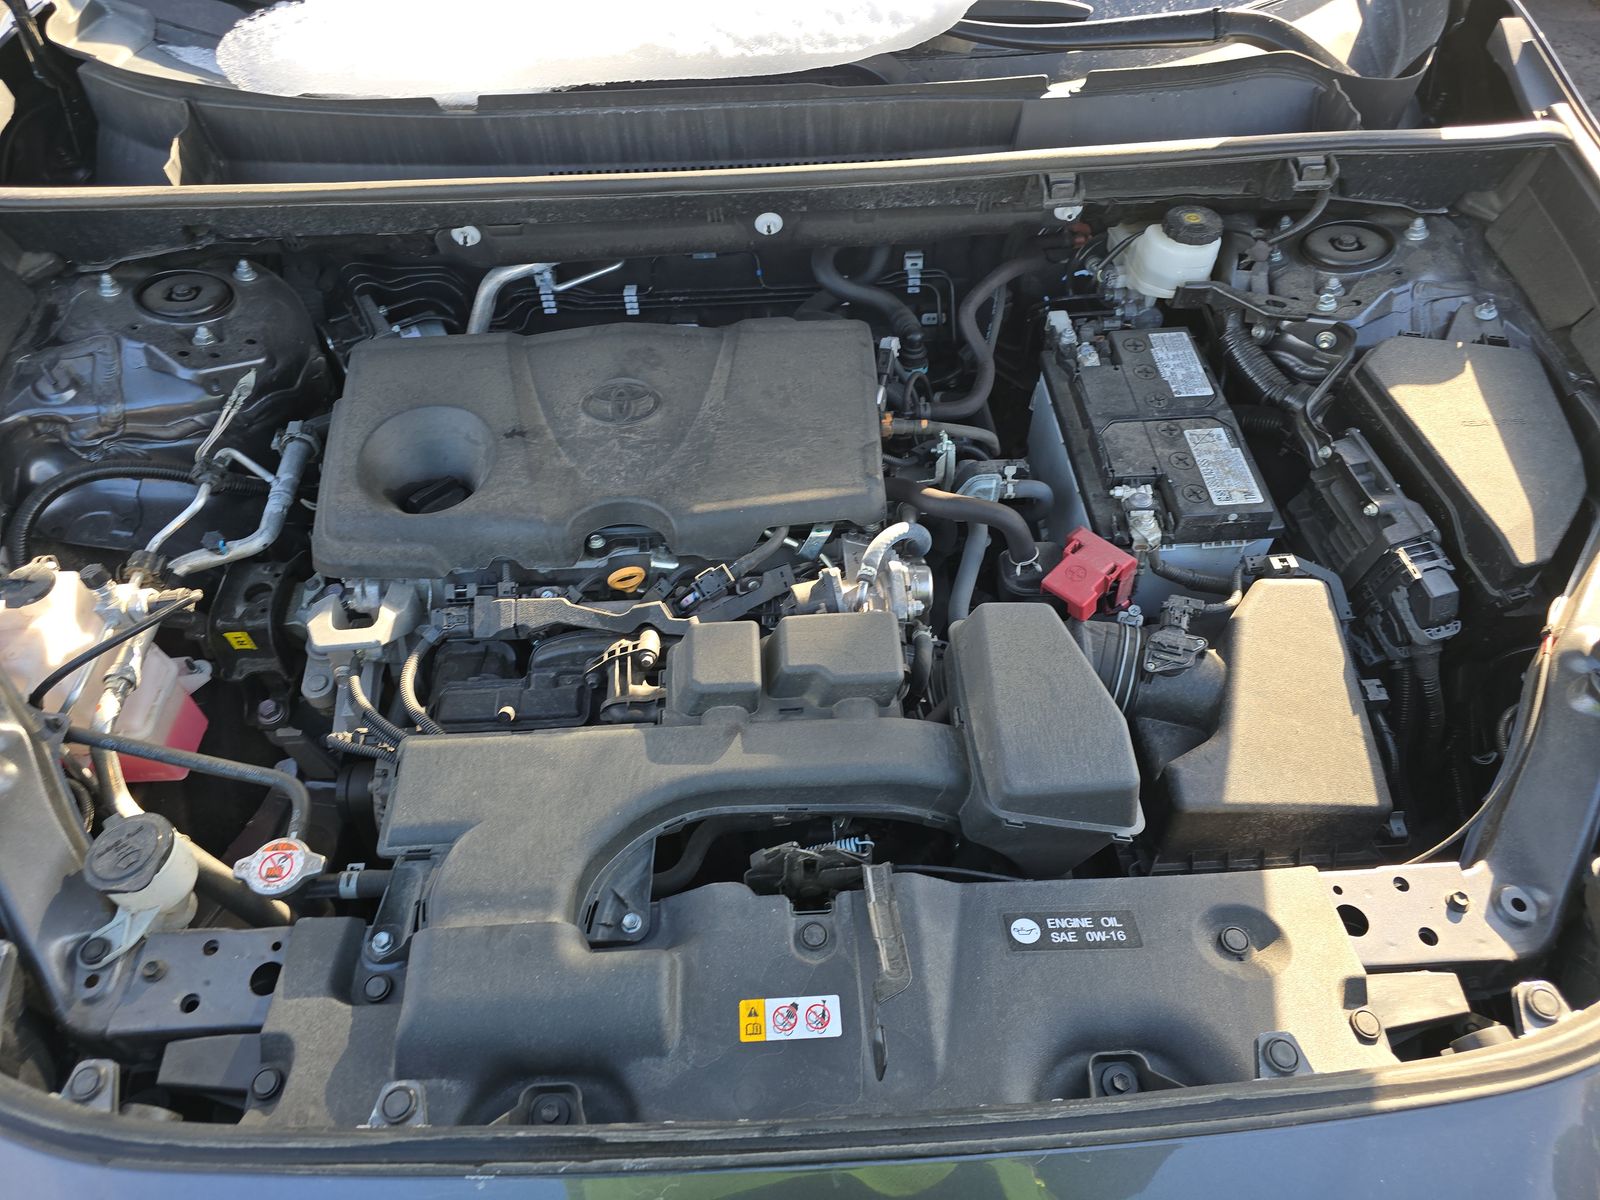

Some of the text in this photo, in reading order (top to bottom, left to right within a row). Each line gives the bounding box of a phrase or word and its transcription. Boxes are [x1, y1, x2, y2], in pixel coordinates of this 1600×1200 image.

[1046, 916, 1123, 929] ENGINE OIL
[1050, 930, 1127, 943] SAE 0W-16
